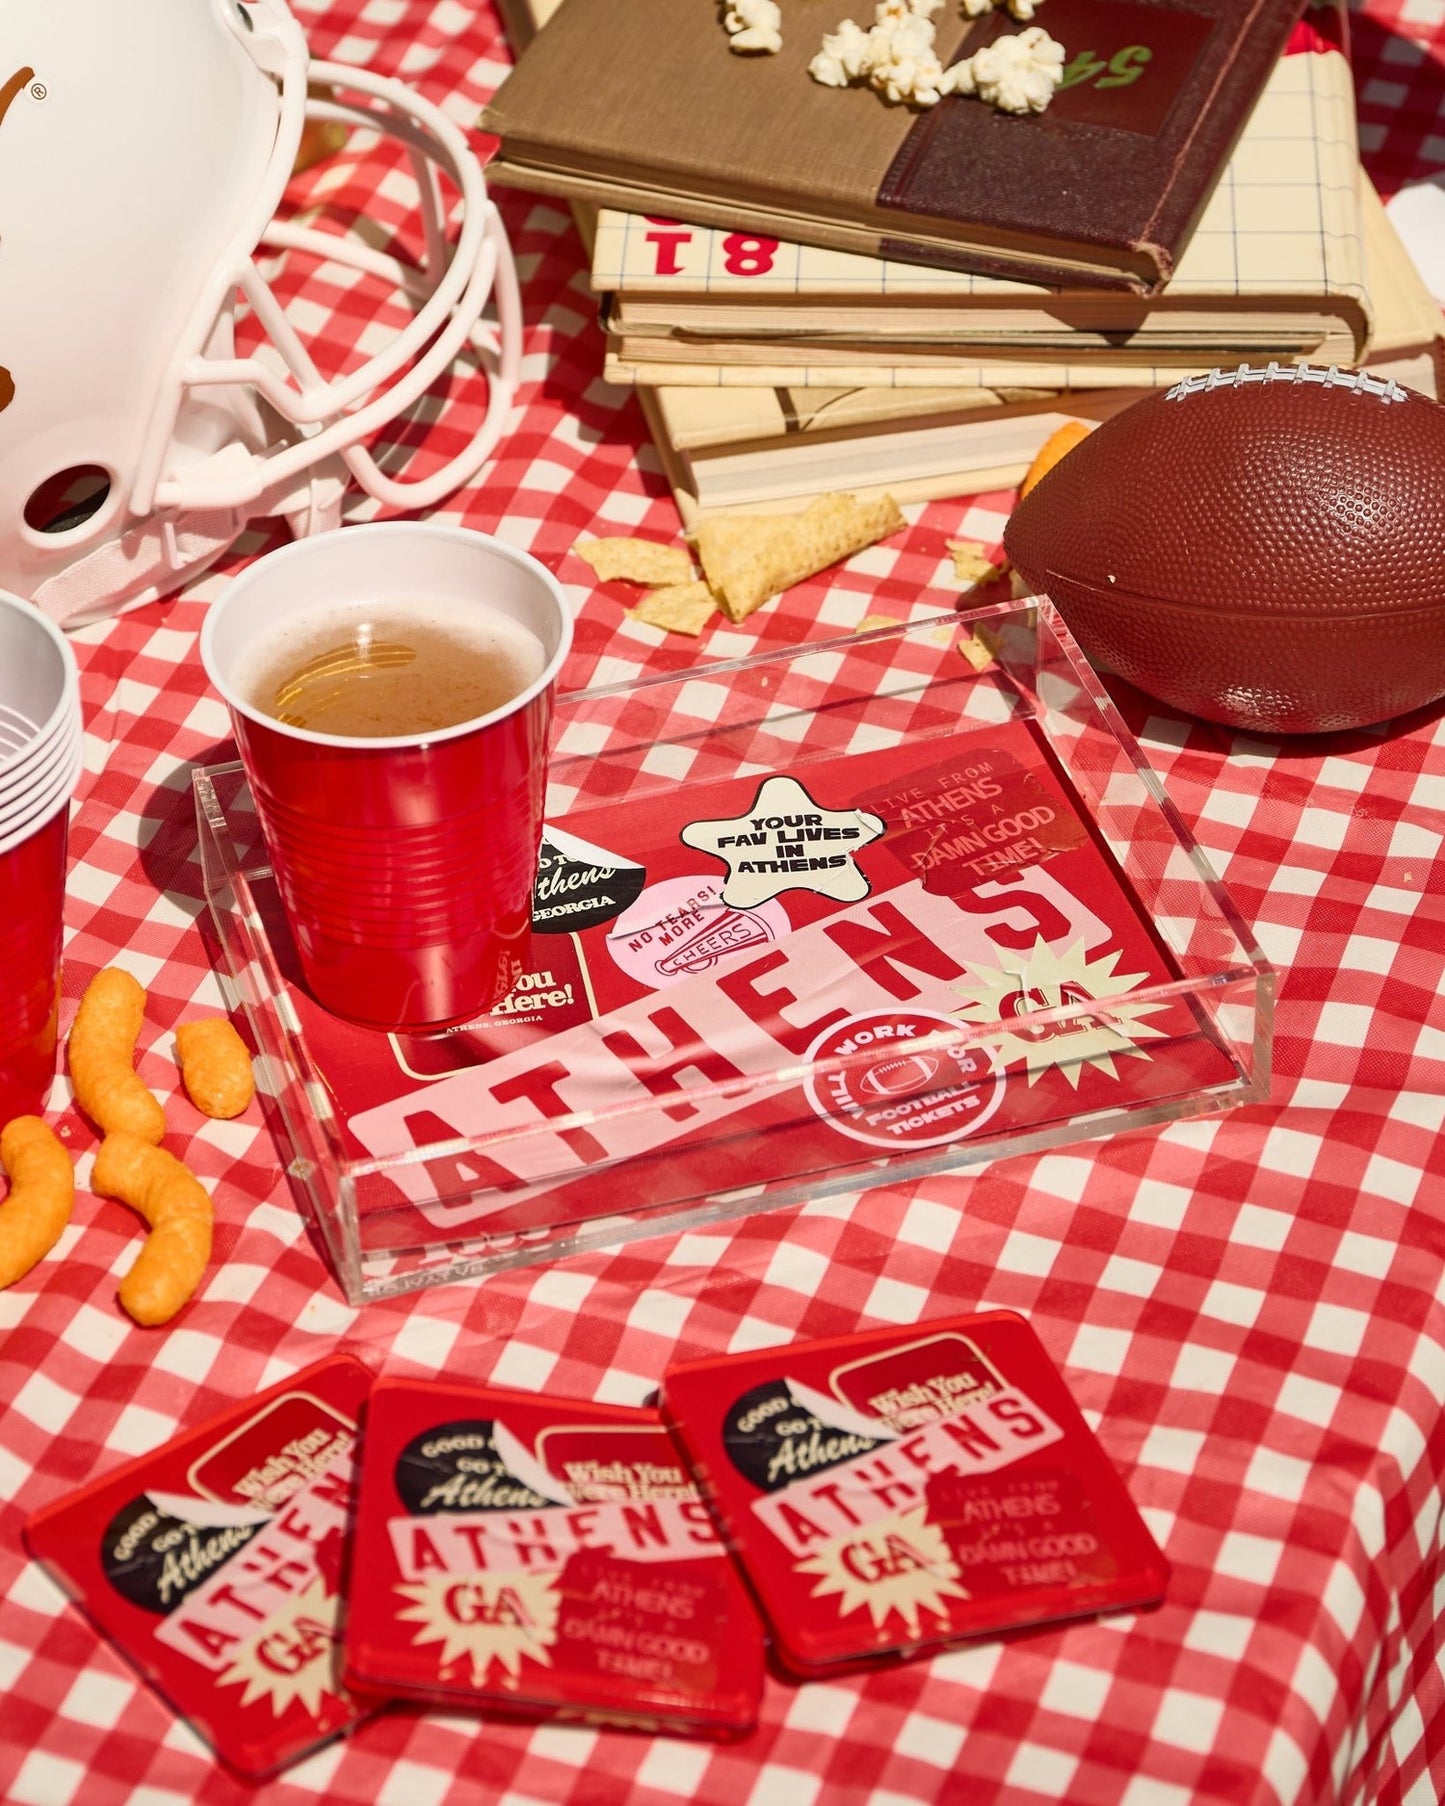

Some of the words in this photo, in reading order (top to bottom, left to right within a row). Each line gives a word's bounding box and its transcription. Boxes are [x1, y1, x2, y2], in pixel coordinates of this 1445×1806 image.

[870, 788, 925, 814] LIVE
[938, 761, 993, 788] FROM
[901, 777, 1003, 828] ATHENS
[718, 832, 767, 848] FAV
[777, 828, 860, 844] LIVES
[750, 814, 823, 831] YOUR
[911, 831, 988, 870] DAMN
[982, 806, 1055, 842] GOOD
[924, 814, 974, 839] IT'S
[991, 804, 1005, 815] A
[738, 855, 847, 873] ATHENS
[776, 844, 804, 858] IN
[962, 837, 1052, 876] TIME!
[534, 866, 616, 900] thens
[628, 931, 653, 953] NO
[655, 885, 717, 932] TEARS!
[658, 911, 705, 946] MORE
[673, 923, 752, 966] CHEERS
[511, 970, 557, 992] ou
[494, 1015, 543, 1028] GEORGIA
[999, 980, 1123, 1043] GA
[402, 868, 1071, 1209] ATHENS
[834, 1024, 917, 1056] WORK
[865, 1081, 982, 1127] FOOTBALL
[886, 1095, 981, 1136] TICKETS
[868, 1382, 934, 1414] Wish
[925, 1371, 979, 1400] You
[737, 1396, 789, 1433] GOOD
[421, 1434, 484, 1458] GOOD
[562, 1460, 633, 1486] Wish
[630, 1462, 683, 1486] You
[775, 1398, 1046, 1546] ATHENS
[963, 1493, 1062, 1524] ATHENS
[412, 1503, 717, 1572] ATHENS
[1027, 1532, 1099, 1559] GOOD
[839, 1533, 936, 1584] GA
[442, 1583, 537, 1627] GA
[590, 1579, 694, 1619] ATHENS
[255, 1615, 336, 1675] GA
[636, 1631, 711, 1664] GOOD
